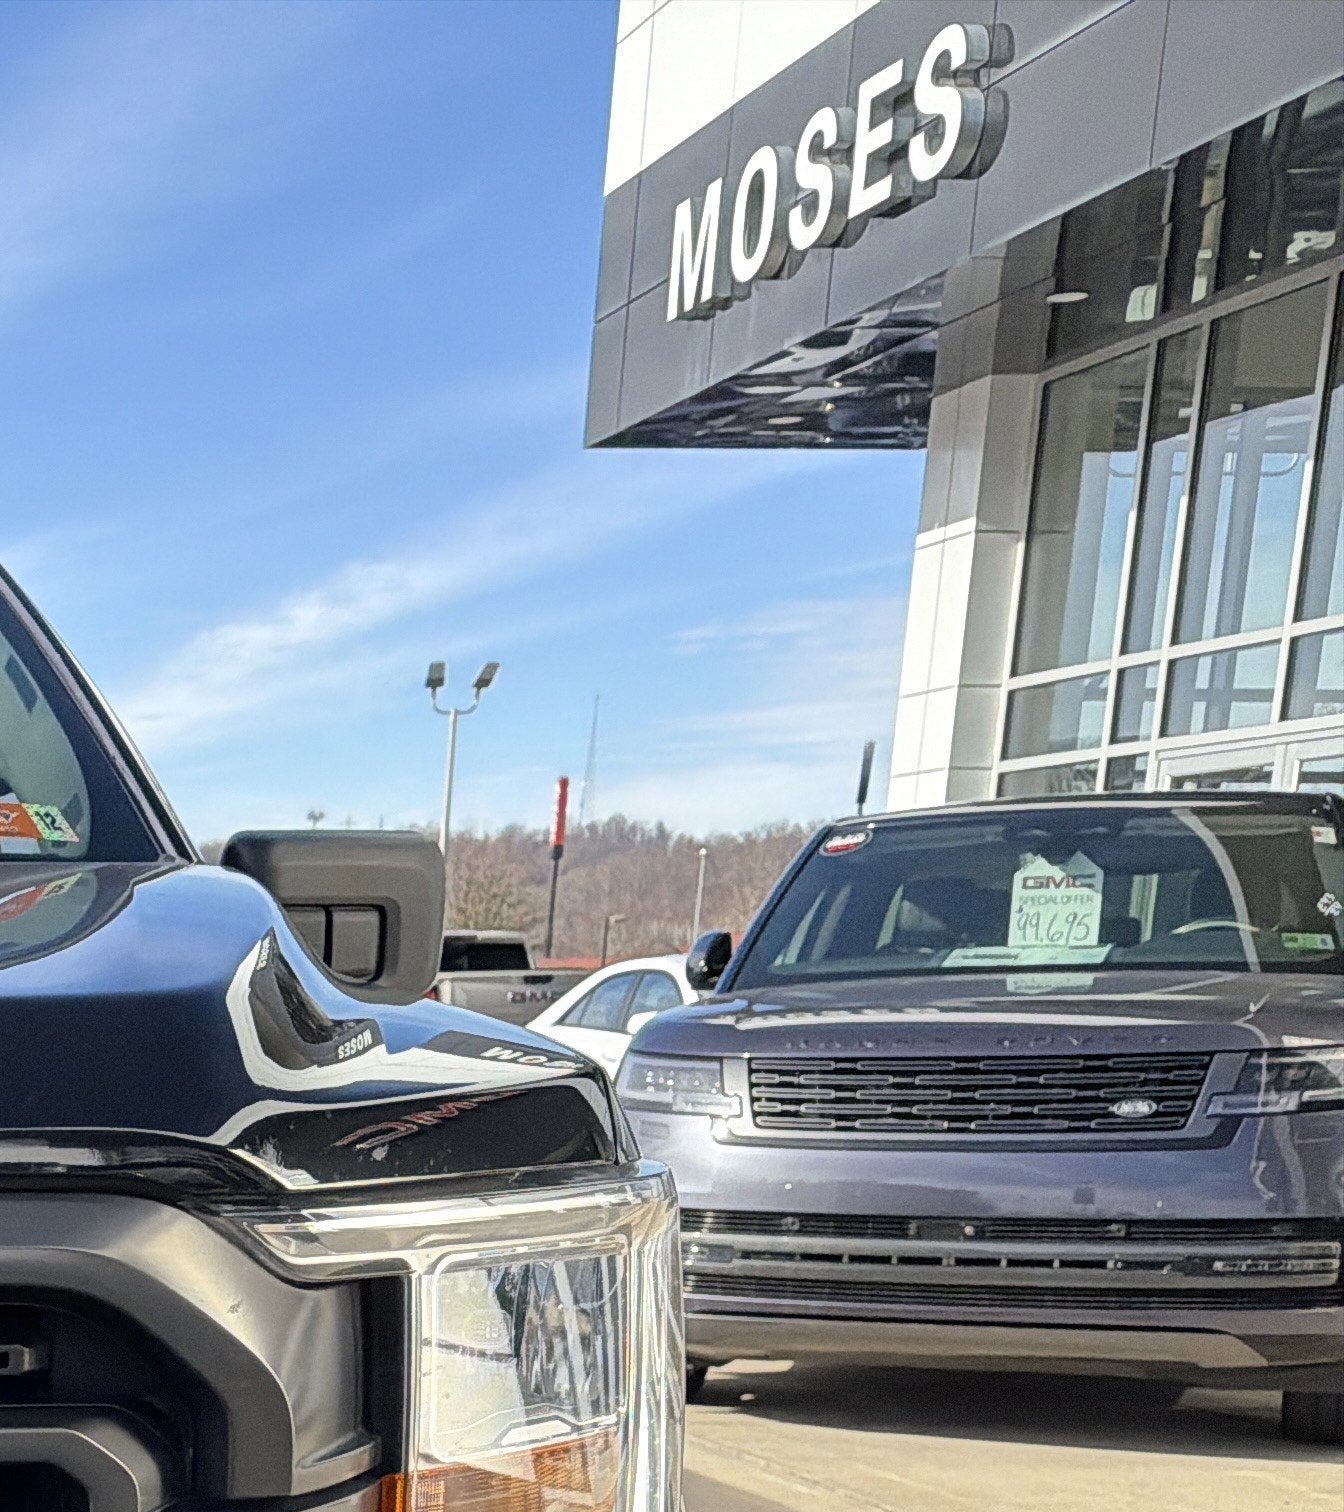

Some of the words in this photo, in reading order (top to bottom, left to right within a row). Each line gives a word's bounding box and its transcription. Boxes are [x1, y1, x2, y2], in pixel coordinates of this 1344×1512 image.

[667, 23, 976, 320] MOSES
[1022, 873, 1097, 890] GMC
[337, 1029, 373, 1060] MOSES
